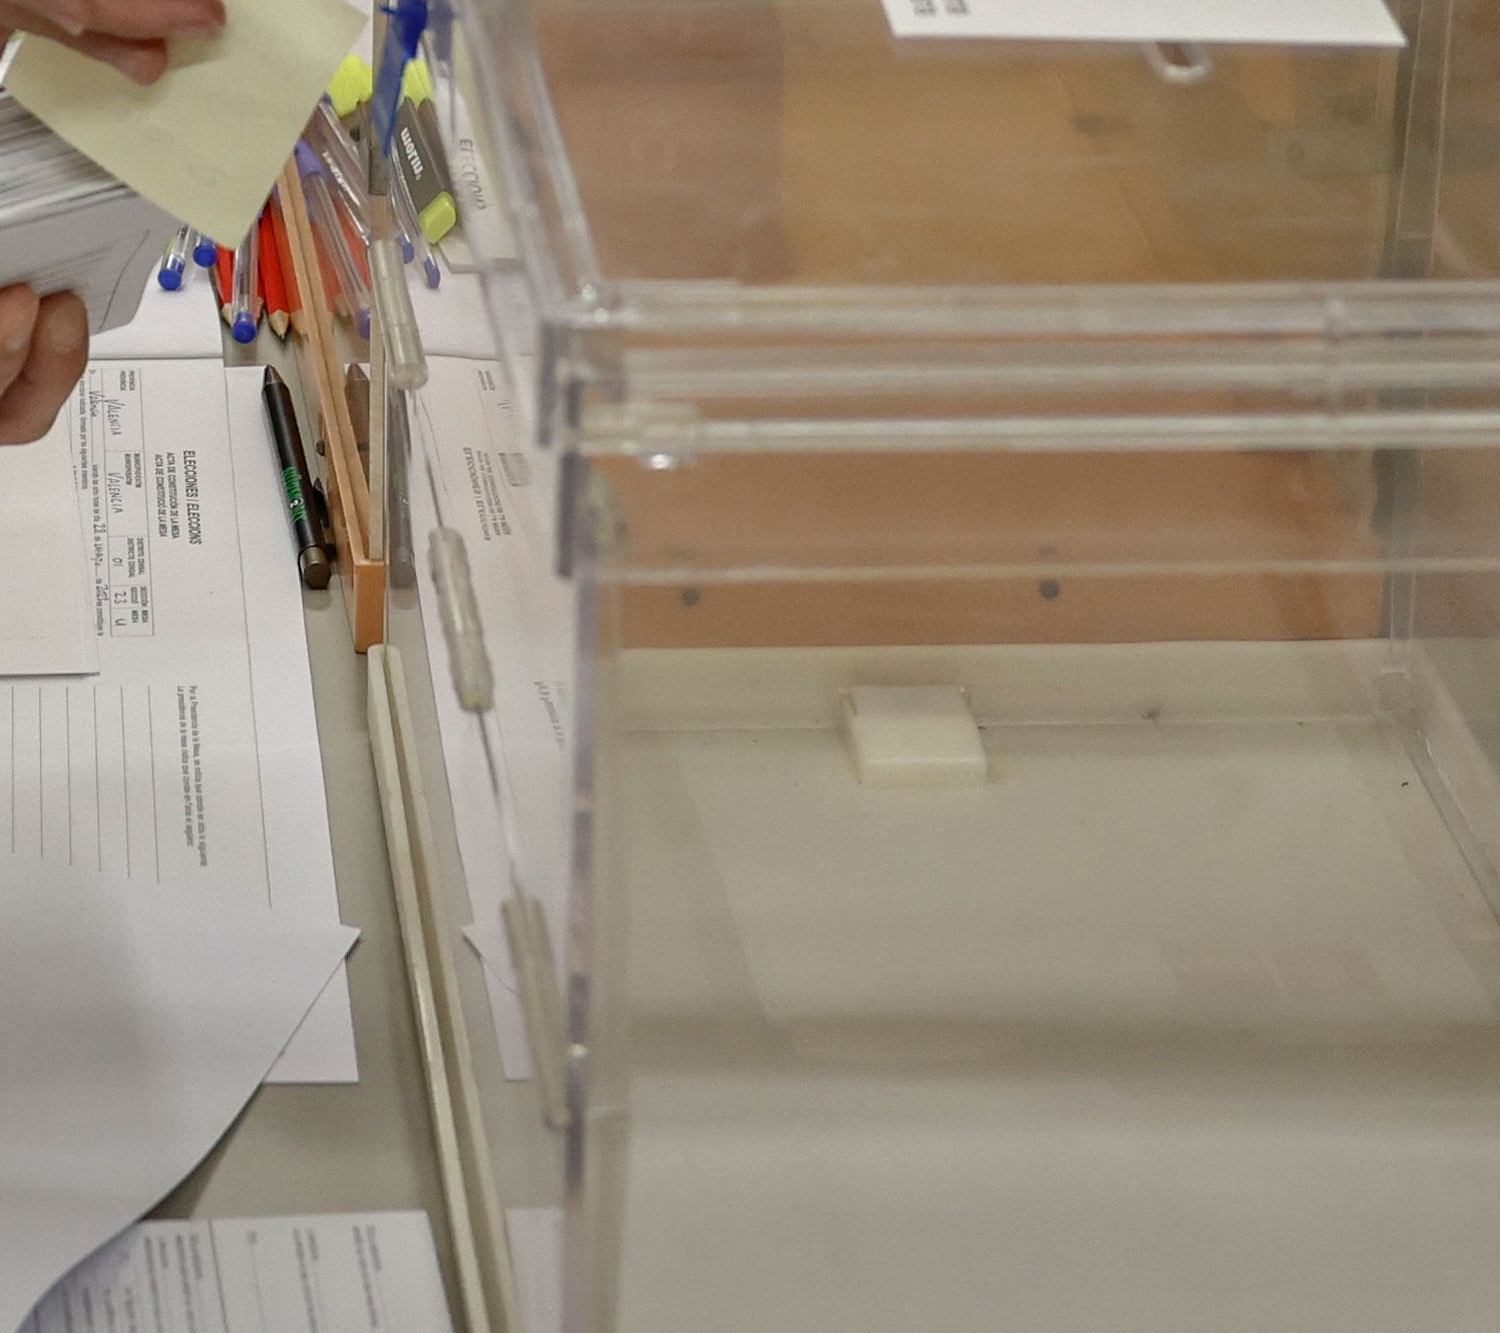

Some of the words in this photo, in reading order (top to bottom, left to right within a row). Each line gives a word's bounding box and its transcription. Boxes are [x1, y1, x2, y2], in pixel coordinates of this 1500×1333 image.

[108, 472, 124, 513] VALENCIA
[183, 450, 199, 498] ELECCIONES
[187, 503, 202, 545] ELECCIONS
[114, 591, 127, 604] 23
